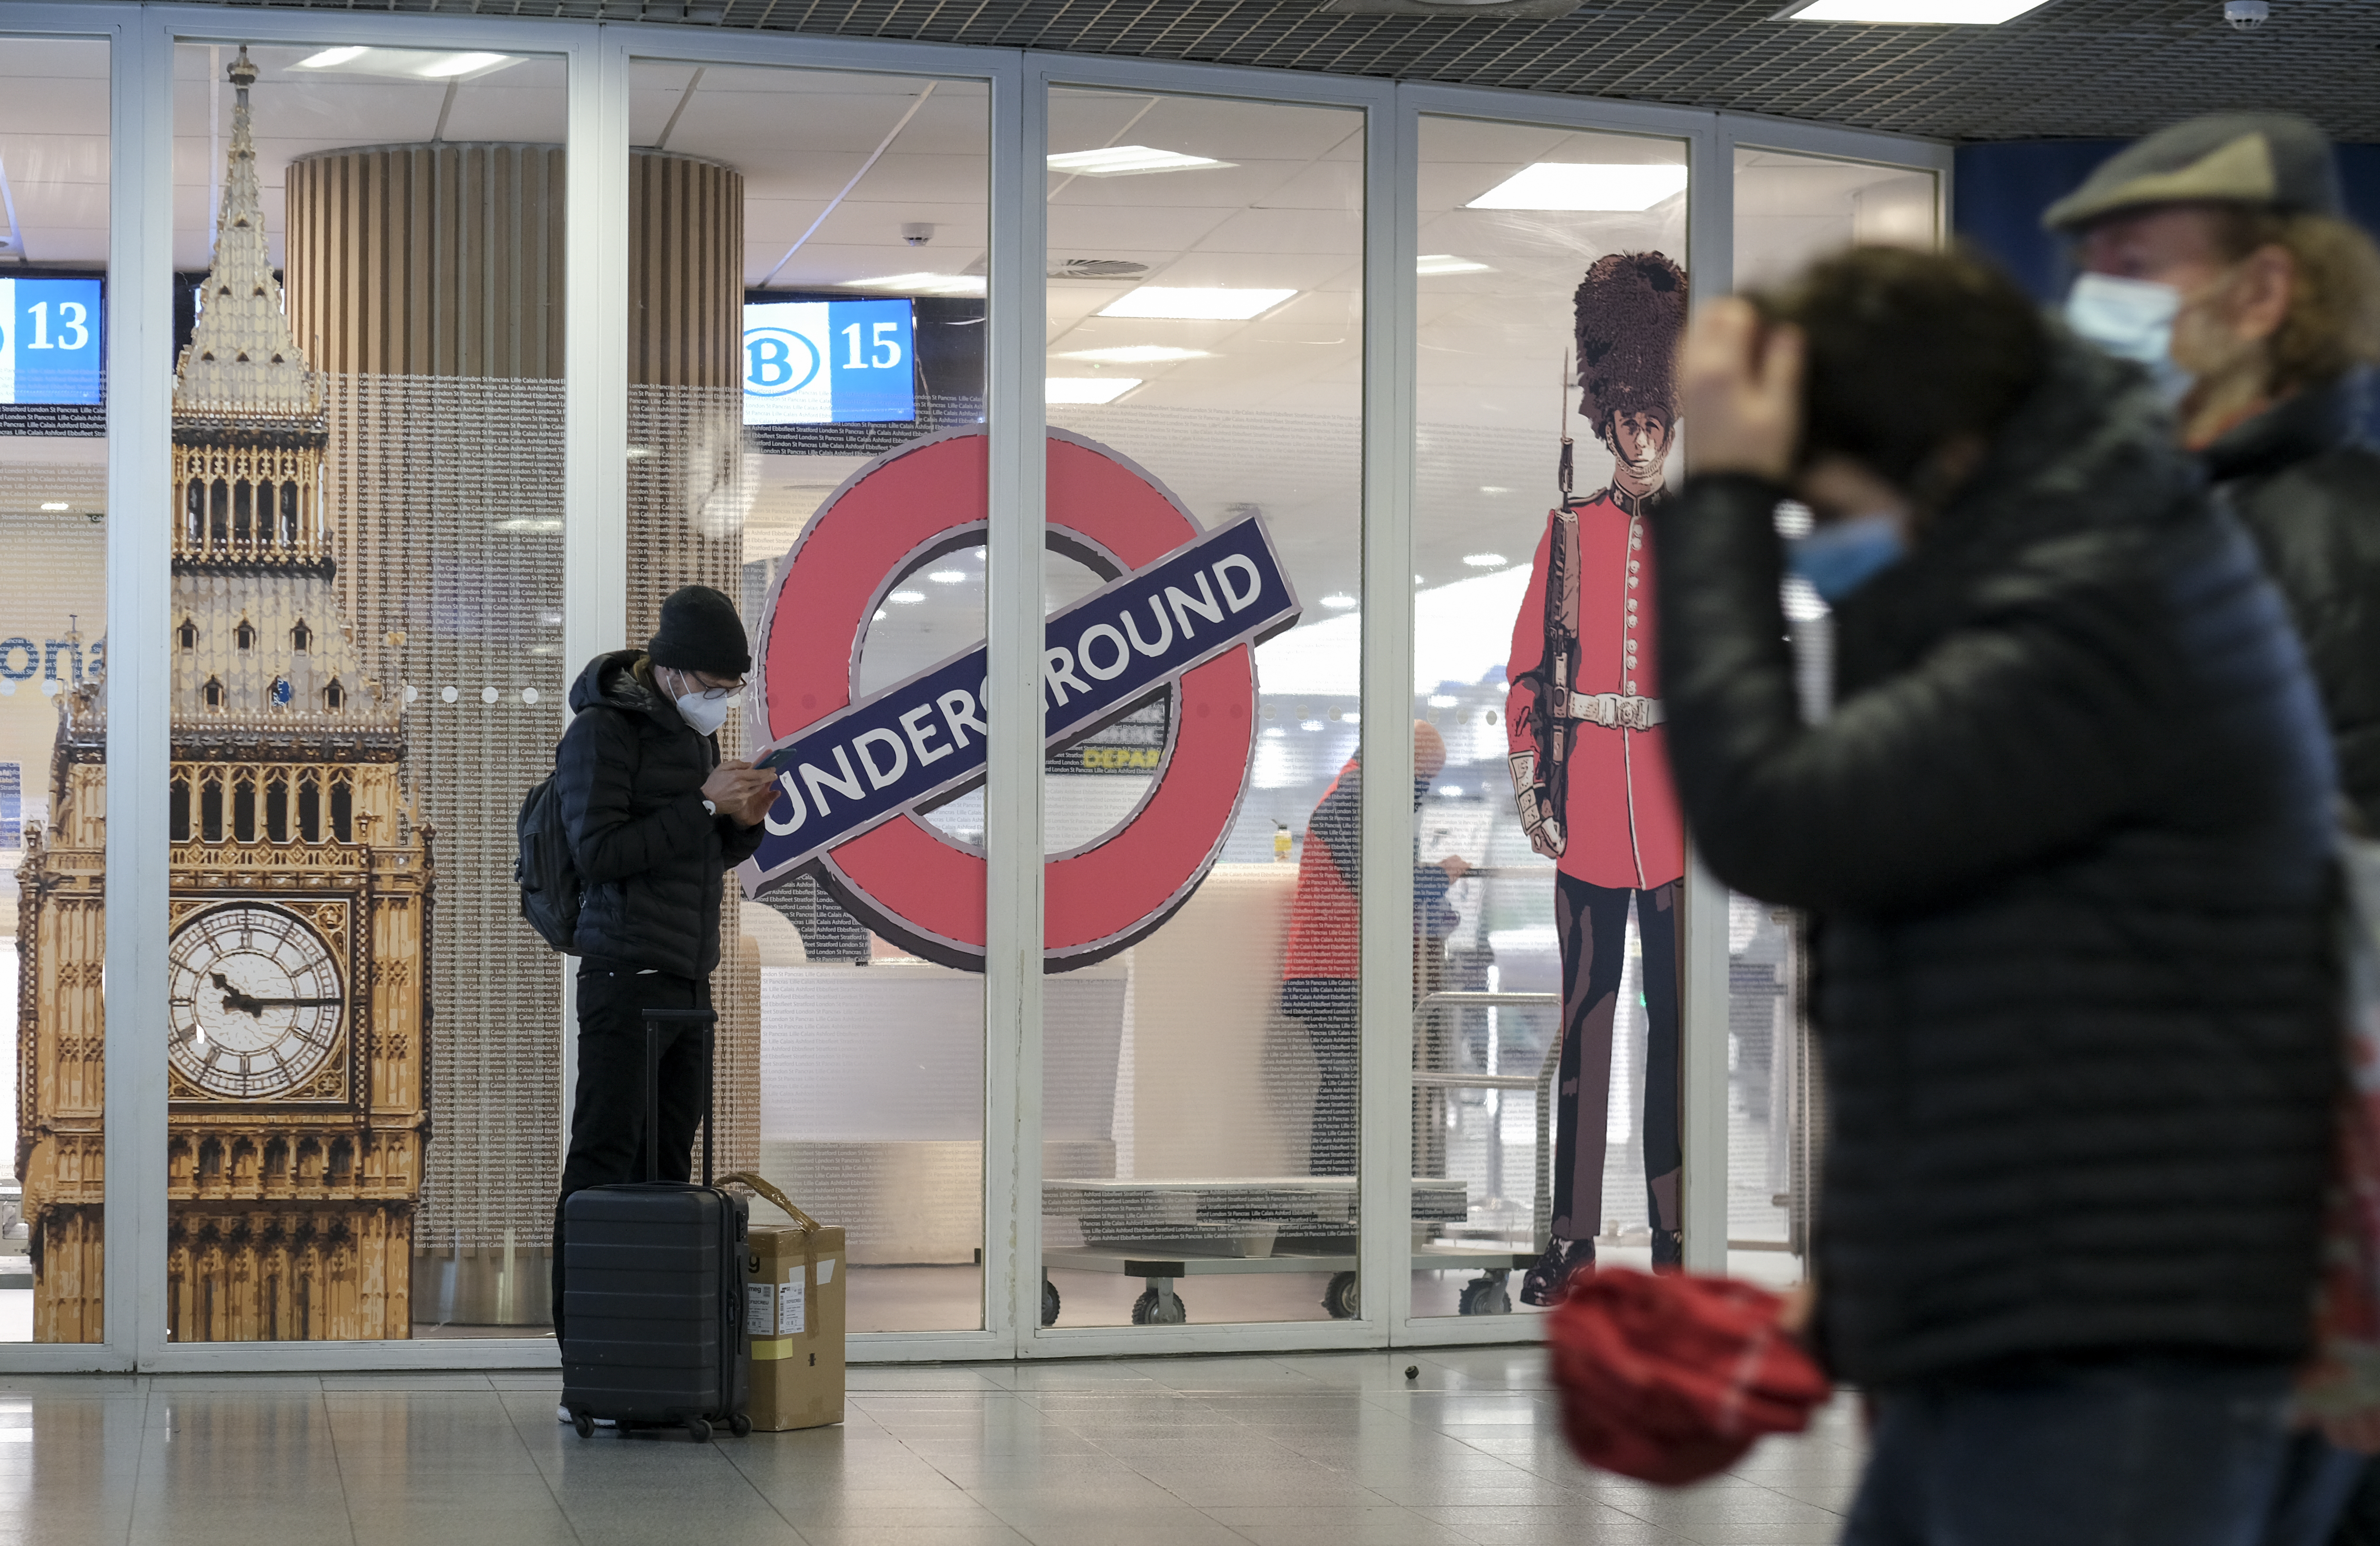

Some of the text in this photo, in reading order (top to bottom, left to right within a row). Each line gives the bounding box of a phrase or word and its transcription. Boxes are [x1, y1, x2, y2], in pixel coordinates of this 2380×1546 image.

[28, 302, 89, 350] 13
[841, 322, 901, 369] 15
[745, 338, 792, 386] B
[764, 553, 1262, 837] UNDERROUND
